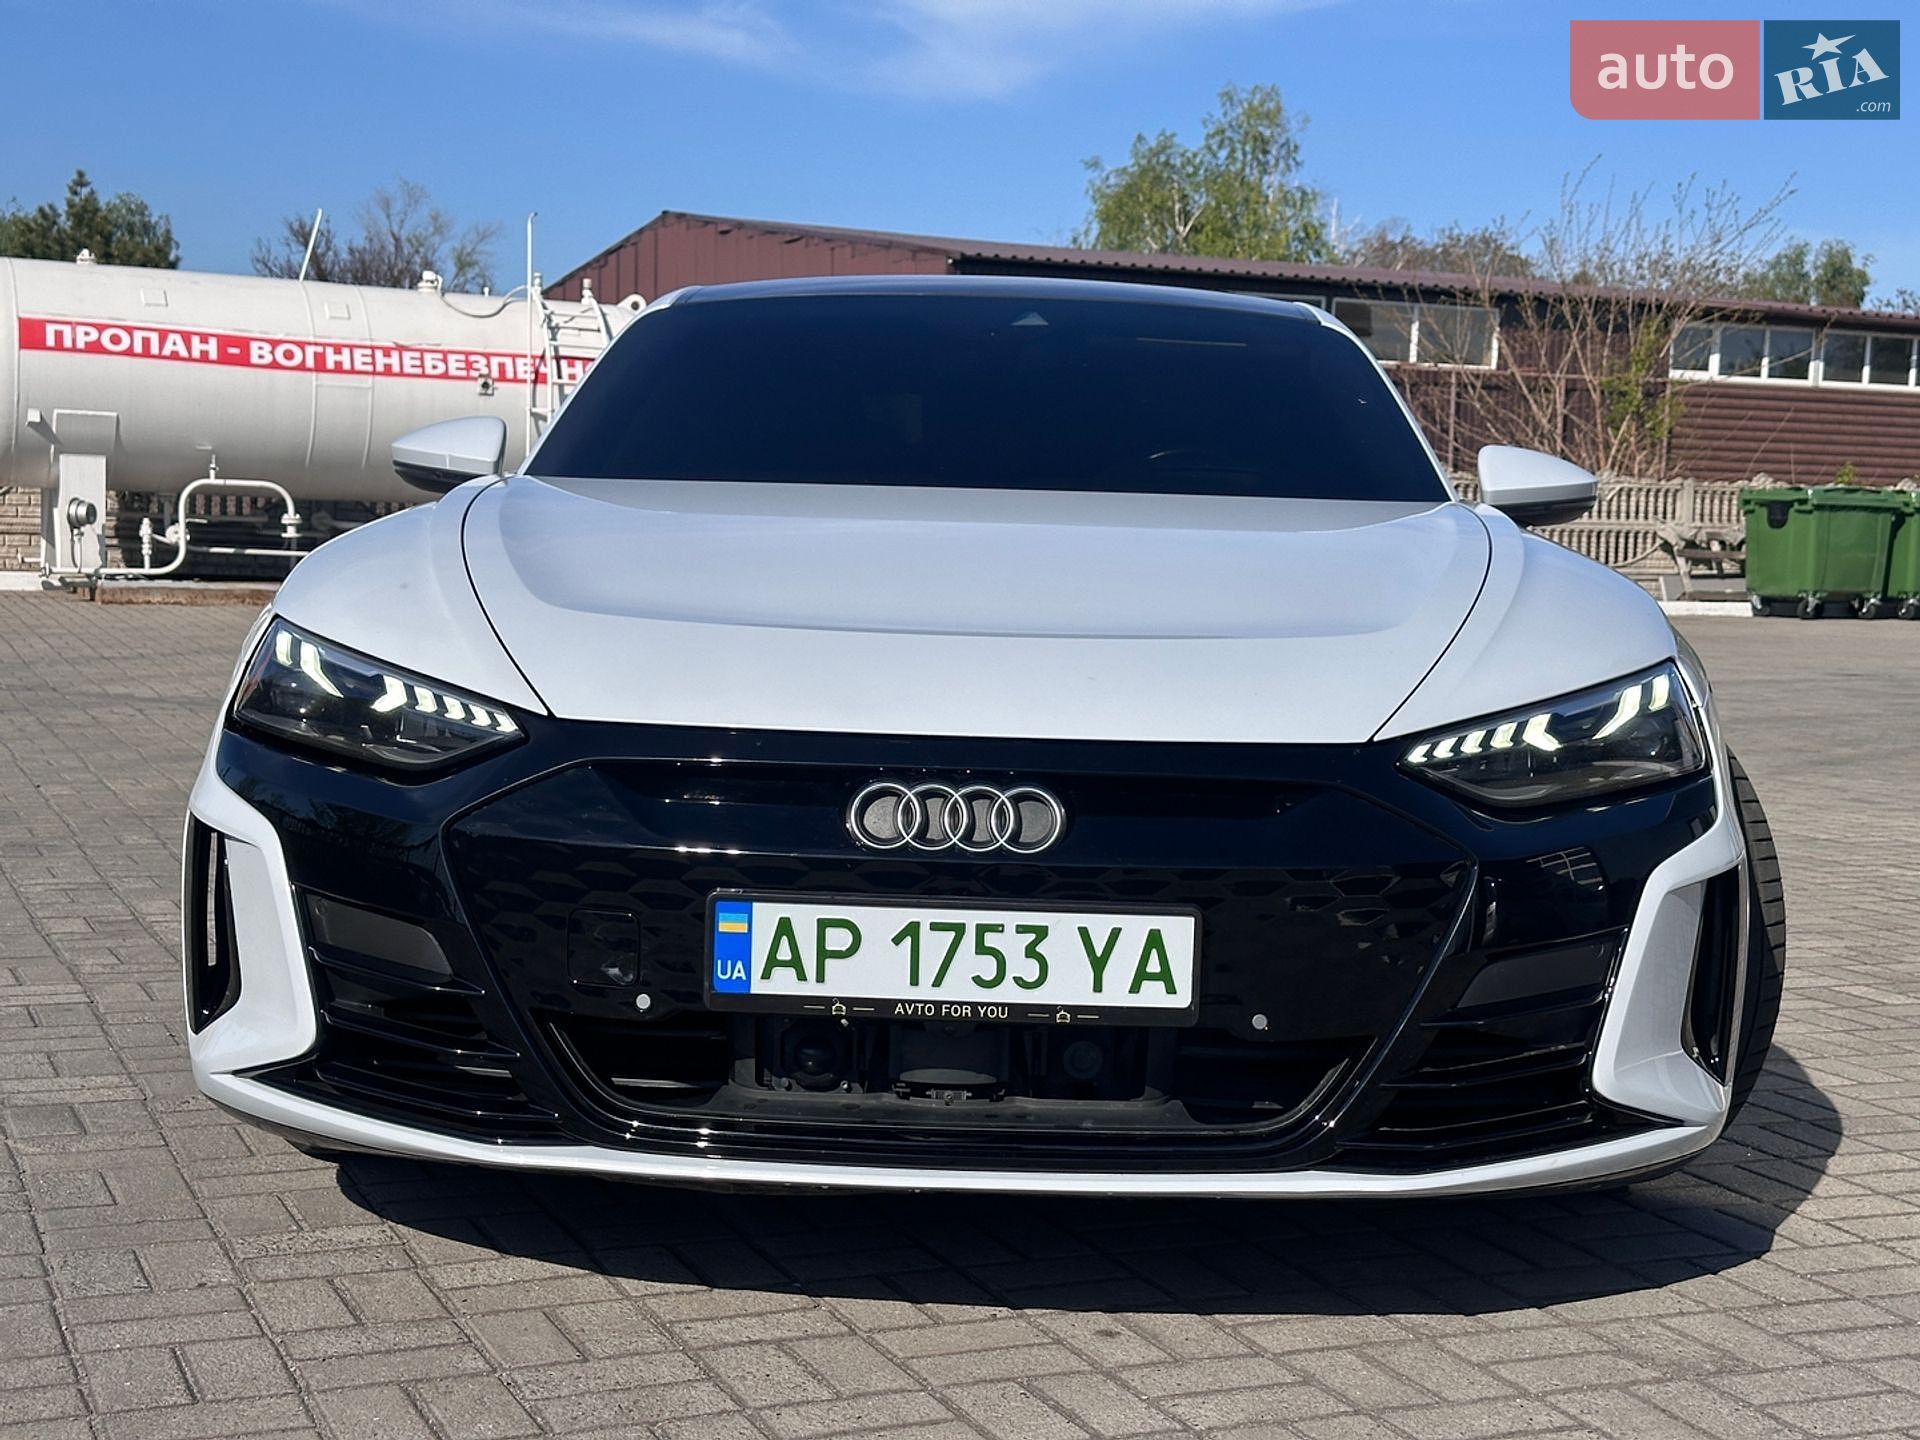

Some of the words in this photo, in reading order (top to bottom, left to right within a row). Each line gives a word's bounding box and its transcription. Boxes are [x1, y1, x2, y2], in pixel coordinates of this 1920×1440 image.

[45, 322, 218, 361] ПРОПАН
[250, 340, 595, 382] ВОГНЕНЕБЕЗПЕЧН
[717, 959, 747, 982] UA
[760, 916, 862, 985] AP
[891, 920, 1050, 991] 1753
[1077, 925, 1177, 995] YA
[894, 1003, 935, 1016] AVTO
[941, 1004, 971, 1017] FOR
[978, 1005, 1008, 1019] YOU
